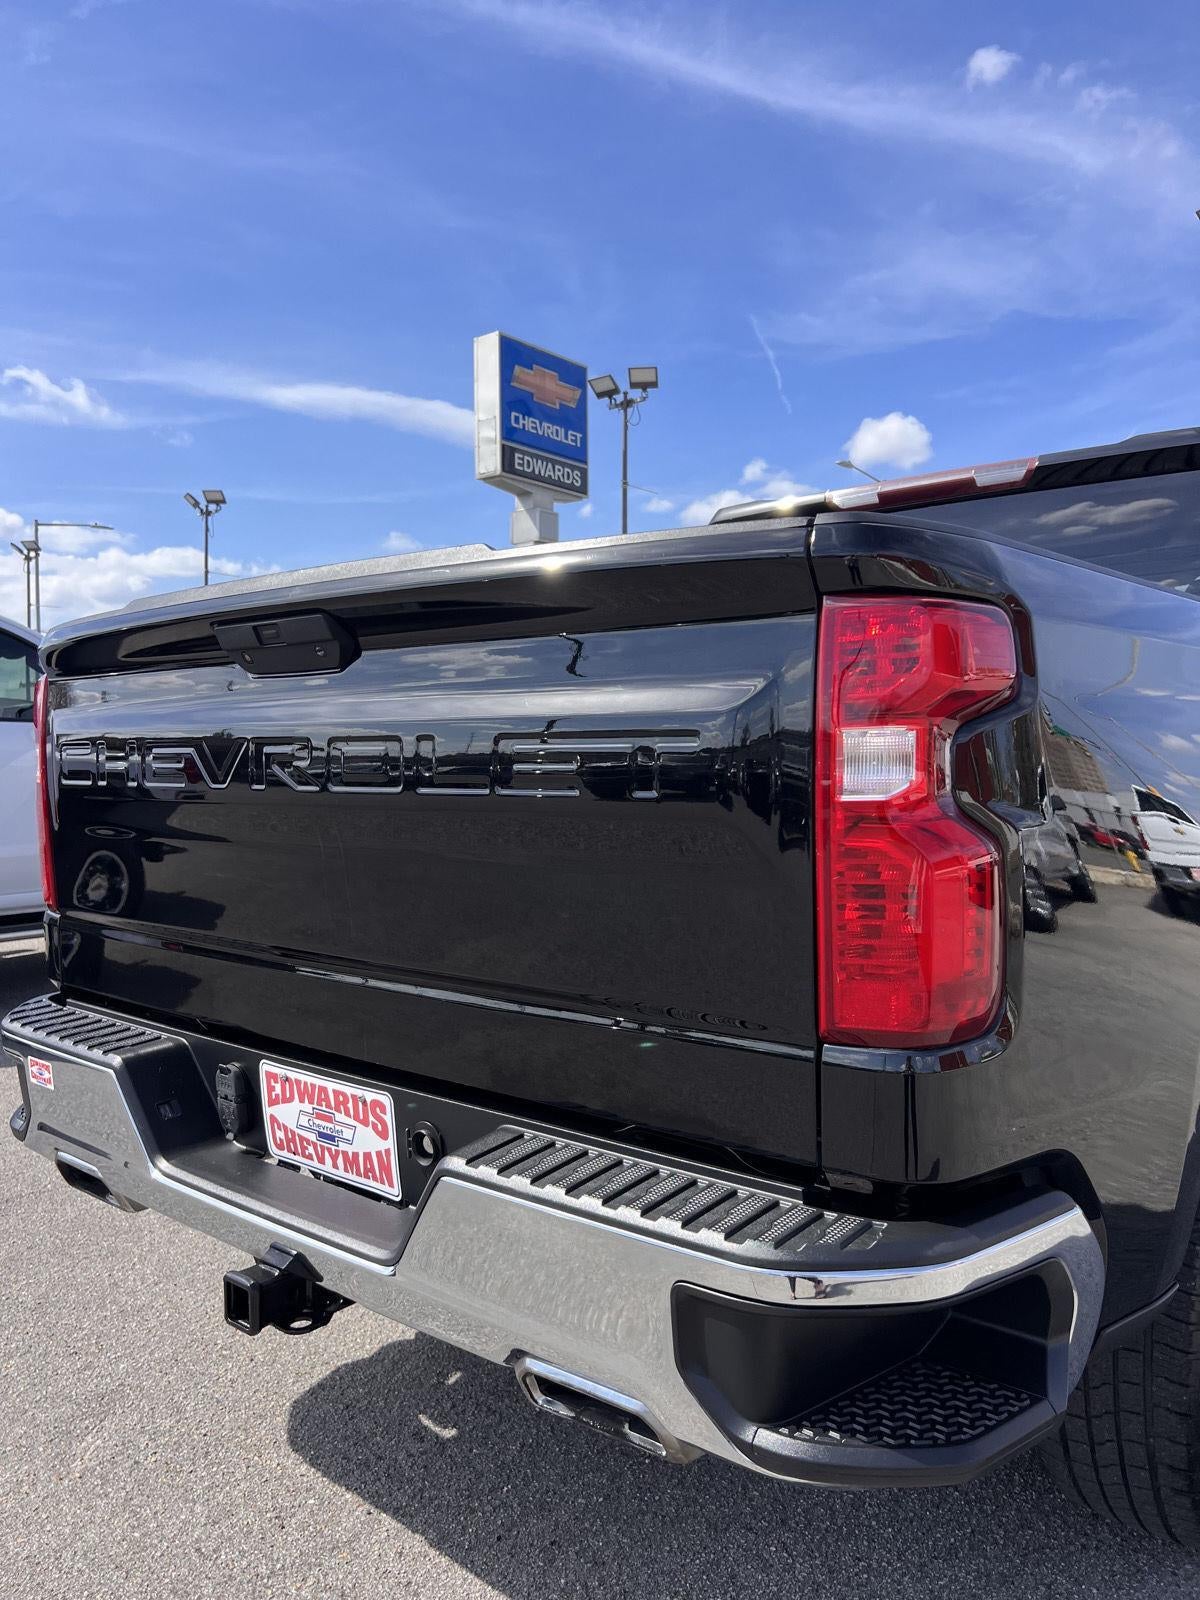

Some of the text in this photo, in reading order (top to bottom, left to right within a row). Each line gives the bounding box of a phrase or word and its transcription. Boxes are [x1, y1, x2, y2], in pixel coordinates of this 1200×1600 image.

[511, 411, 582, 448] CHEVROLET
[515, 453, 581, 487] EDWARDS
[59, 729, 702, 801] CHEVROLET
[265, 1070, 389, 1141] EDWARDS
[308, 1118, 344, 1136] Chevrolet
[268, 1113, 395, 1189] CHEVYMAN
